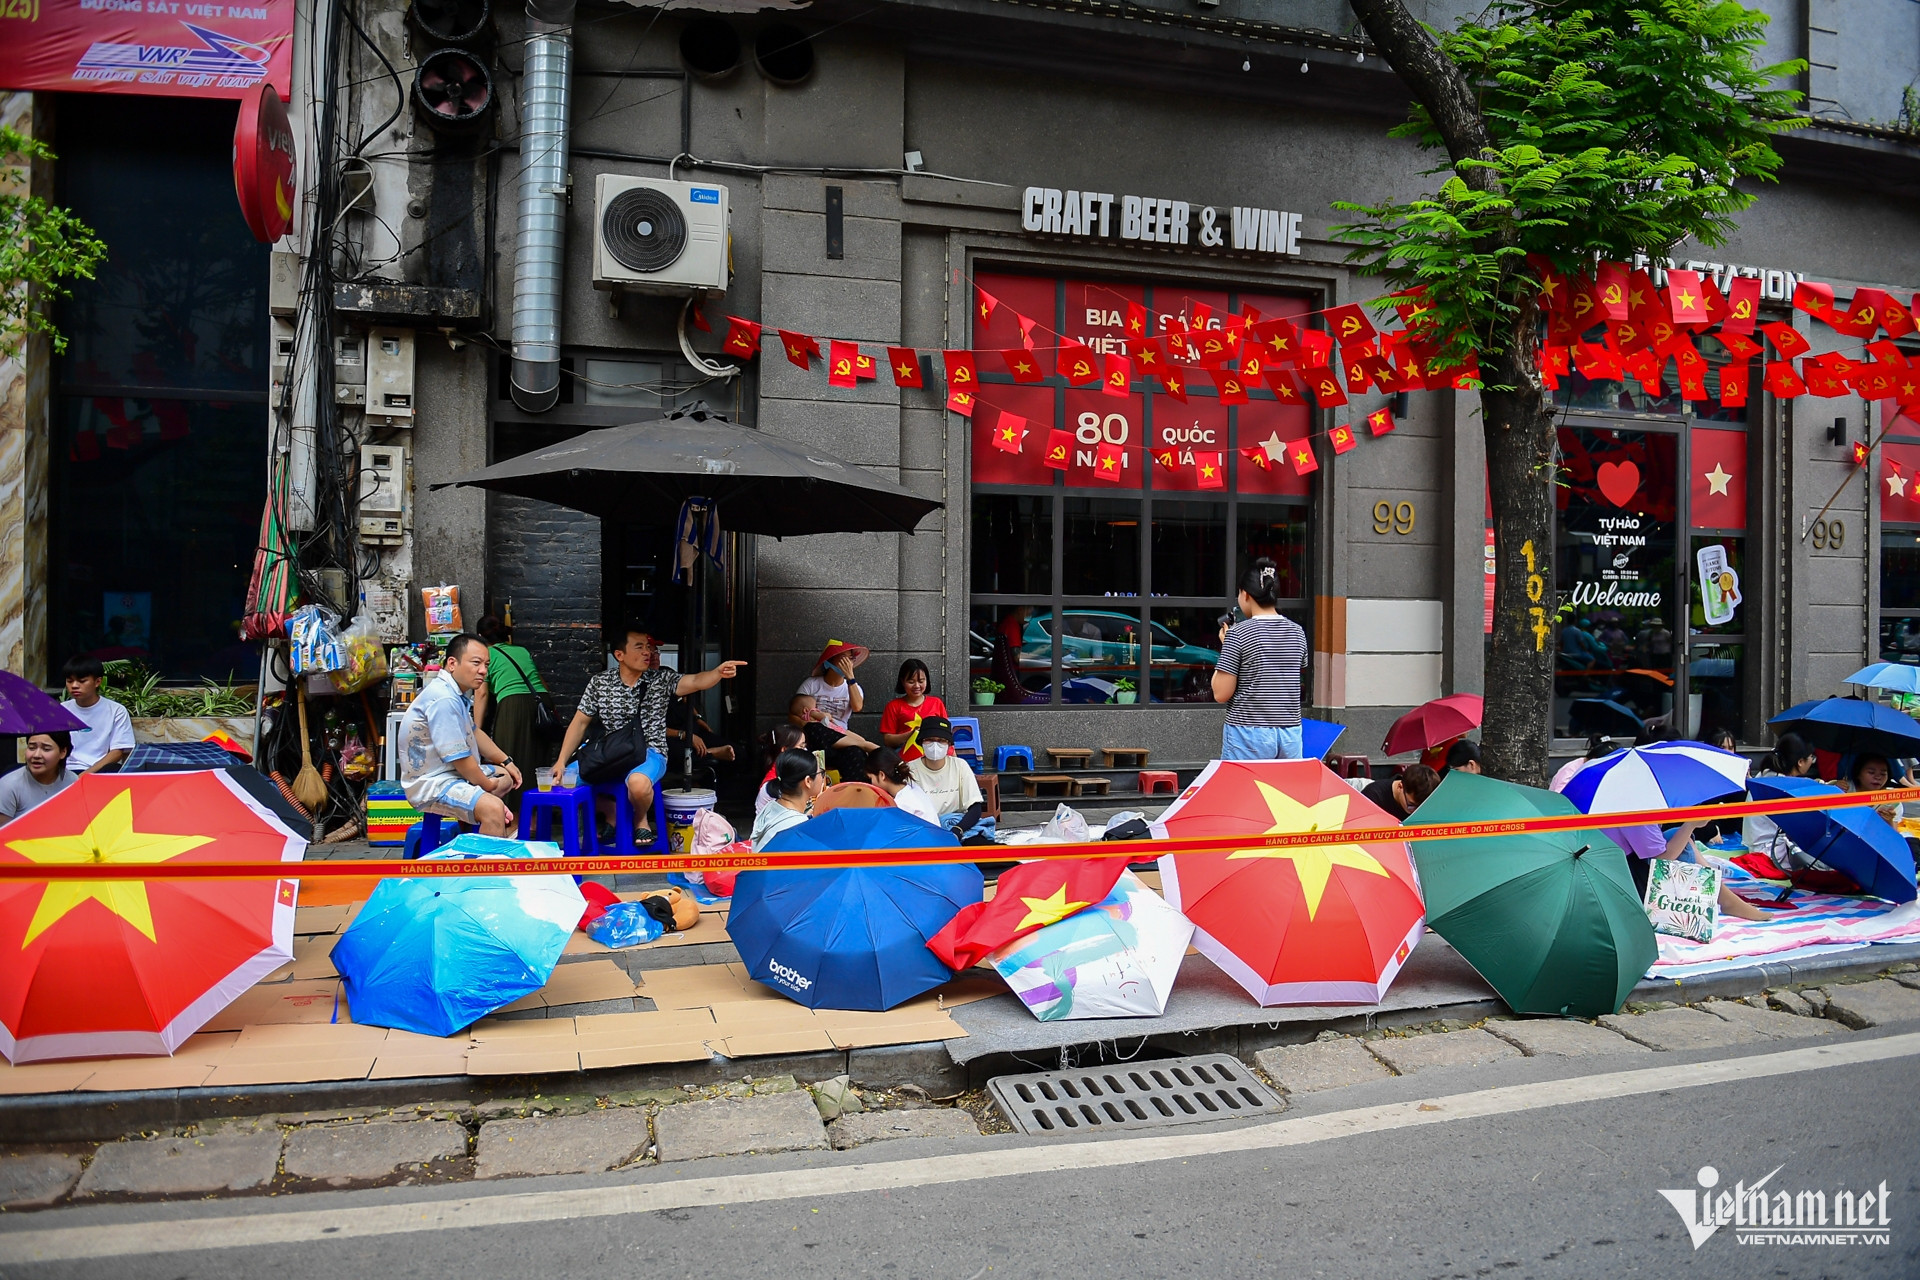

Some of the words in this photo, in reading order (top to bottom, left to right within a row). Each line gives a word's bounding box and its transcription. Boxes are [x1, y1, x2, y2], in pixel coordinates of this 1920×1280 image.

[185, 2, 224, 18] VIỆT
[228, 6, 267, 20] NAM
[137, 46, 188, 64] VNR
[1023, 186, 1114, 237] CRAFT
[1121, 195, 1190, 244] BEER
[1200, 206, 1224, 247] &
[1232, 206, 1303, 255] WINE
[1086, 308, 1124, 327] BIA
[1076, 411, 1129, 445] 80
[1162, 420, 1216, 445] QUỐC
[1373, 500, 1415, 535] 99
[1599, 517, 1616, 531] TỰ
[1616, 516, 1640, 529] HÀO
[1592, 532, 1619, 548] VIỆT
[1620, 535, 1646, 546] NAM
[1813, 519, 1845, 549] 99
[1572, 580, 1661, 608] Welcome
[1421, 828, 1448, 836] POLICE
[1483, 824, 1499, 832] NOT
[1500, 823, 1525, 831] CROSS
[552, 861, 585, 872] VƯỢT
[588, 862, 610, 870] QUA
[620, 861, 658, 869] POLICE
[661, 860, 688, 868] LINE.
[691, 859, 707, 867] DO
[709, 859, 730, 867] NOT
[733, 858, 768, 866] CROSS
[1657, 894, 1706, 915] Green
[769, 958, 812, 990] brother
[778, 977, 790, 987] your
[790, 984, 801, 992] side
